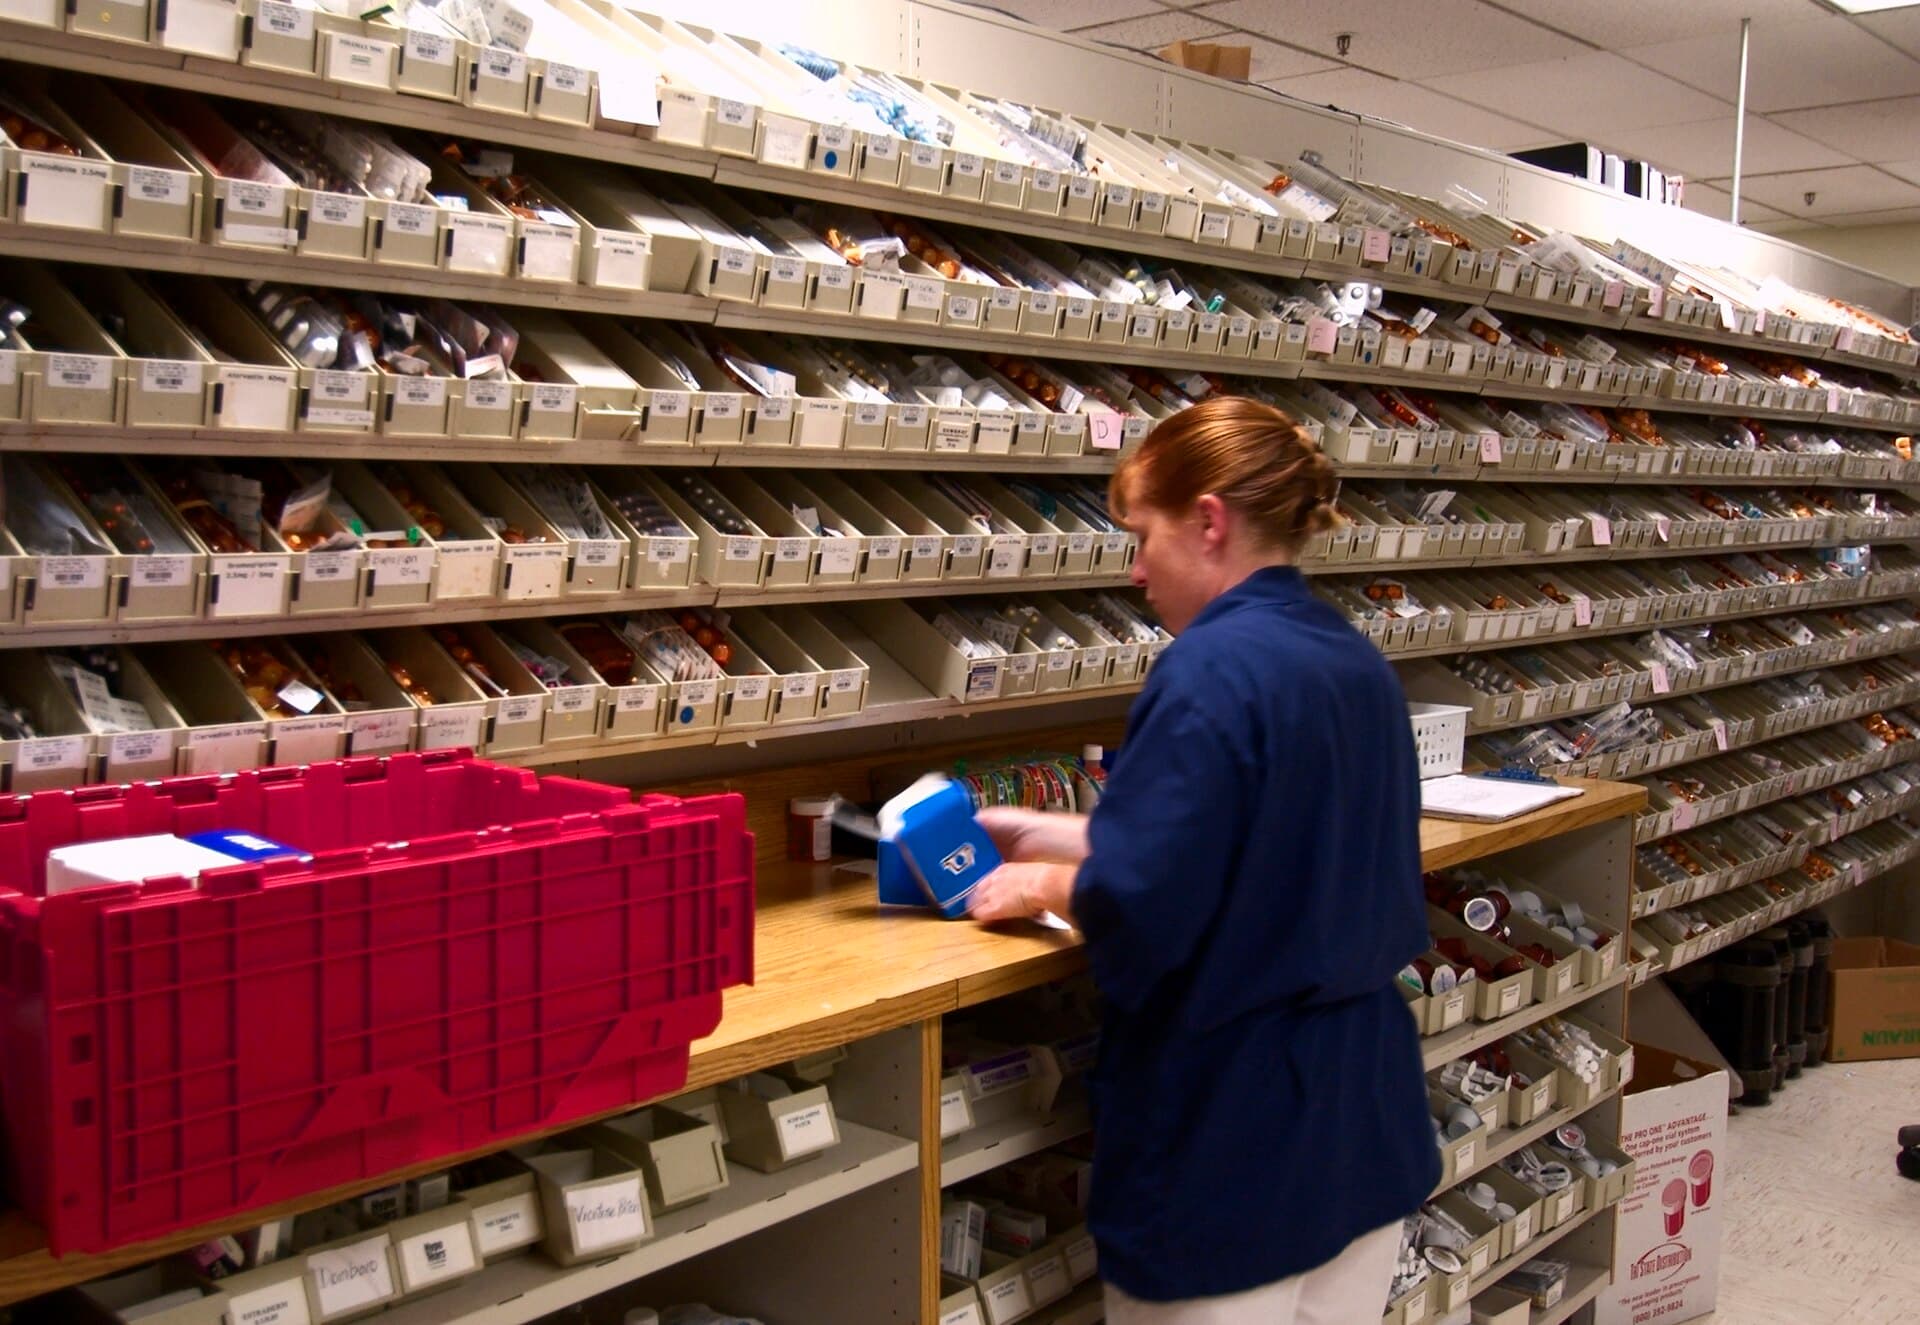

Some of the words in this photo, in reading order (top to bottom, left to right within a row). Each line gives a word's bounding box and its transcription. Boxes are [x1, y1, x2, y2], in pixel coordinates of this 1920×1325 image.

[1096, 420, 1109, 440] D
[1634, 1129, 1648, 1140] PRO
[1655, 1144, 1663, 1153] by
[1664, 1140, 1679, 1152] your
[1680, 1131, 1713, 1146] customers
